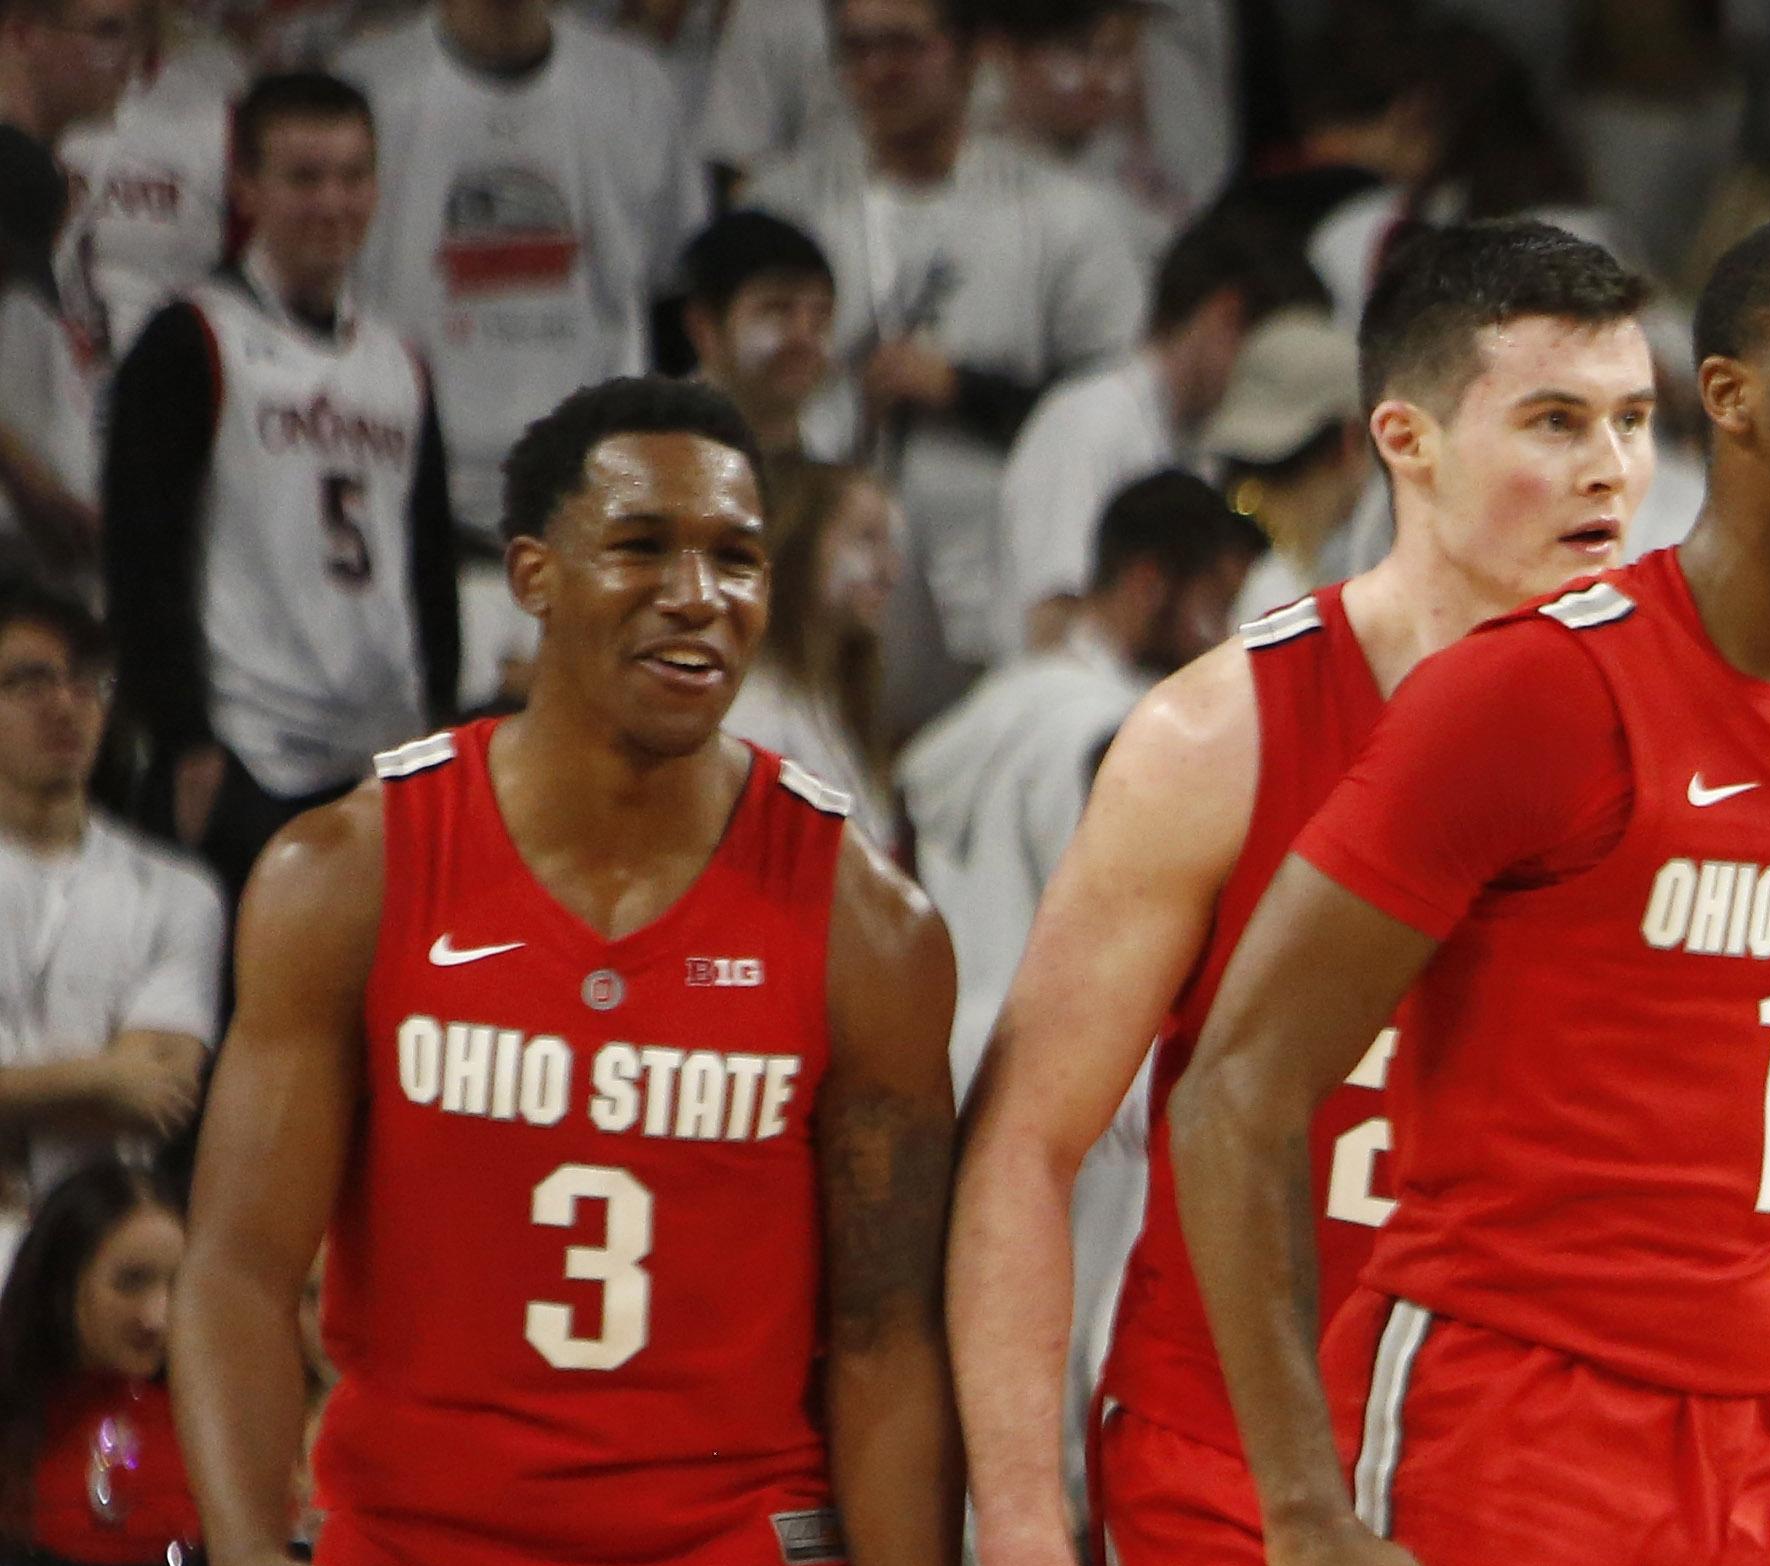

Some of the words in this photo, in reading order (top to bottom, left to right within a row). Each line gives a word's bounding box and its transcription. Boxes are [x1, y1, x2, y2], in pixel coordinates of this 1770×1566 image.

[319, 472, 374, 592] 5
[397, 1014, 572, 1126] OHIO
[588, 1041, 801, 1143] STATE
[524, 1162, 654, 1371] 3
